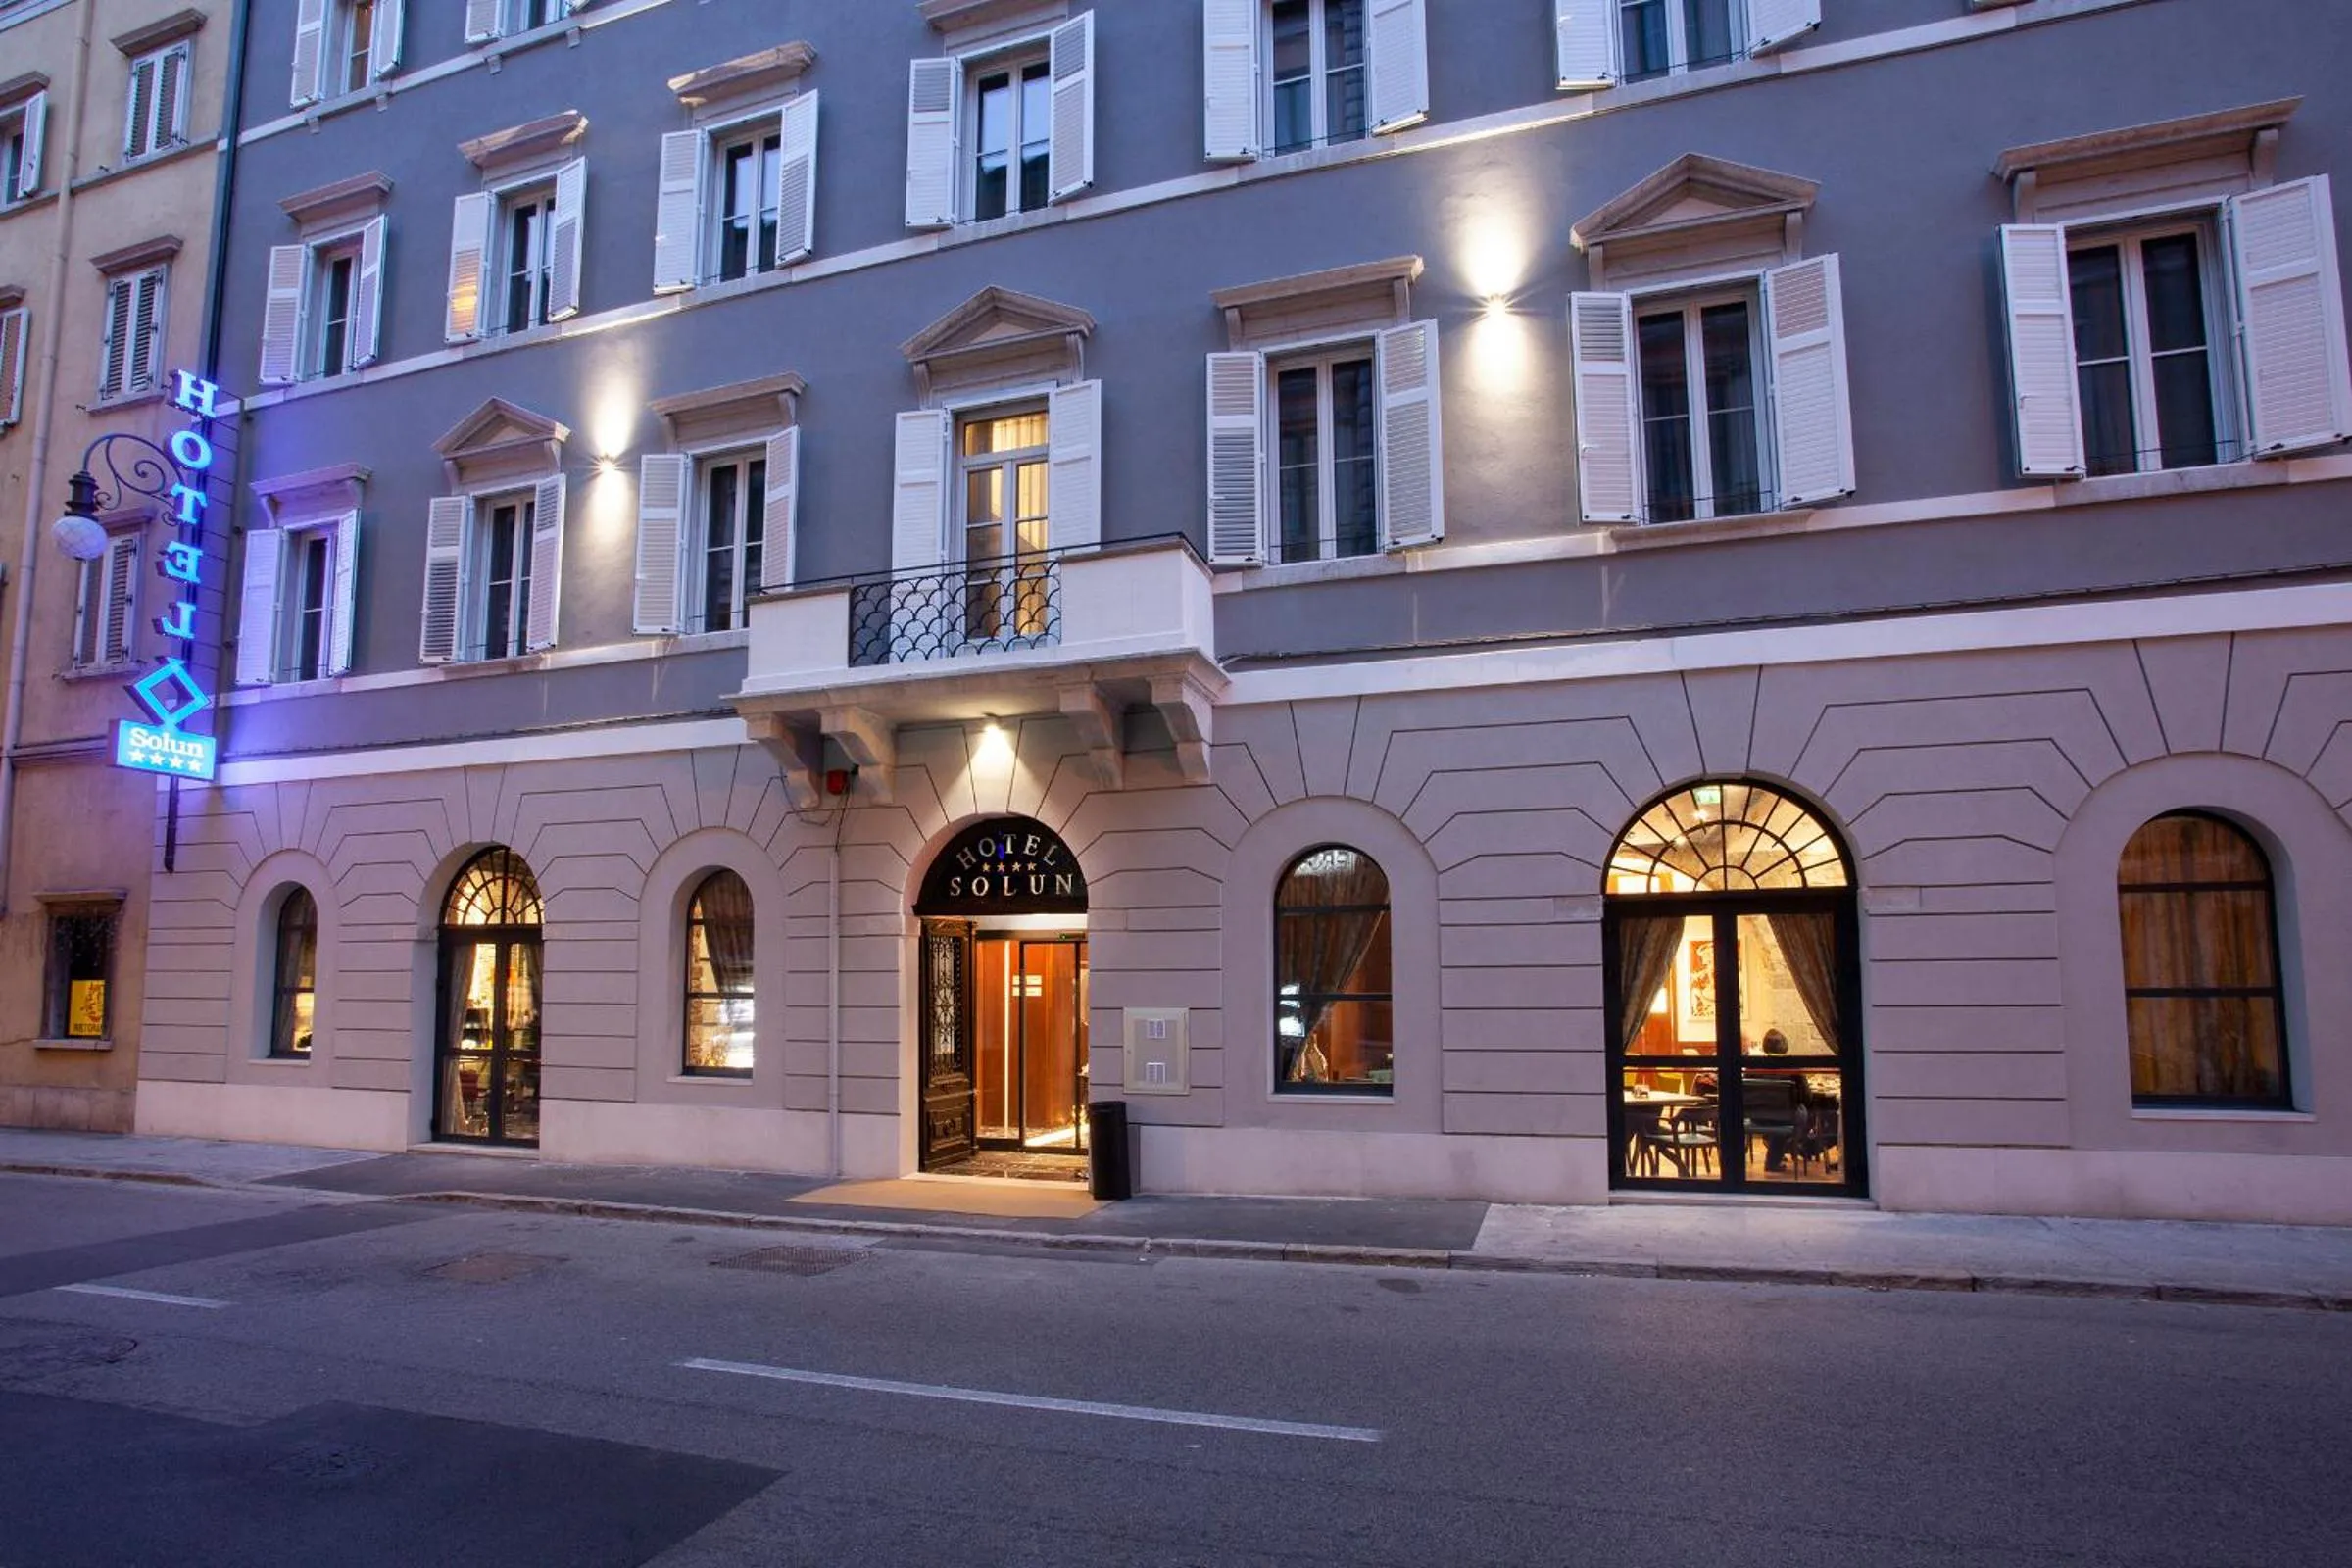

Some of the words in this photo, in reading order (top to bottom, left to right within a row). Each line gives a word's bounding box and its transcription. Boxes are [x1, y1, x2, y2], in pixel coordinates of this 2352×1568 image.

[129, 726, 205, 759] Solun
[956, 833, 1059, 870] HOTEL
[949, 874, 1074, 897] SOLUN
